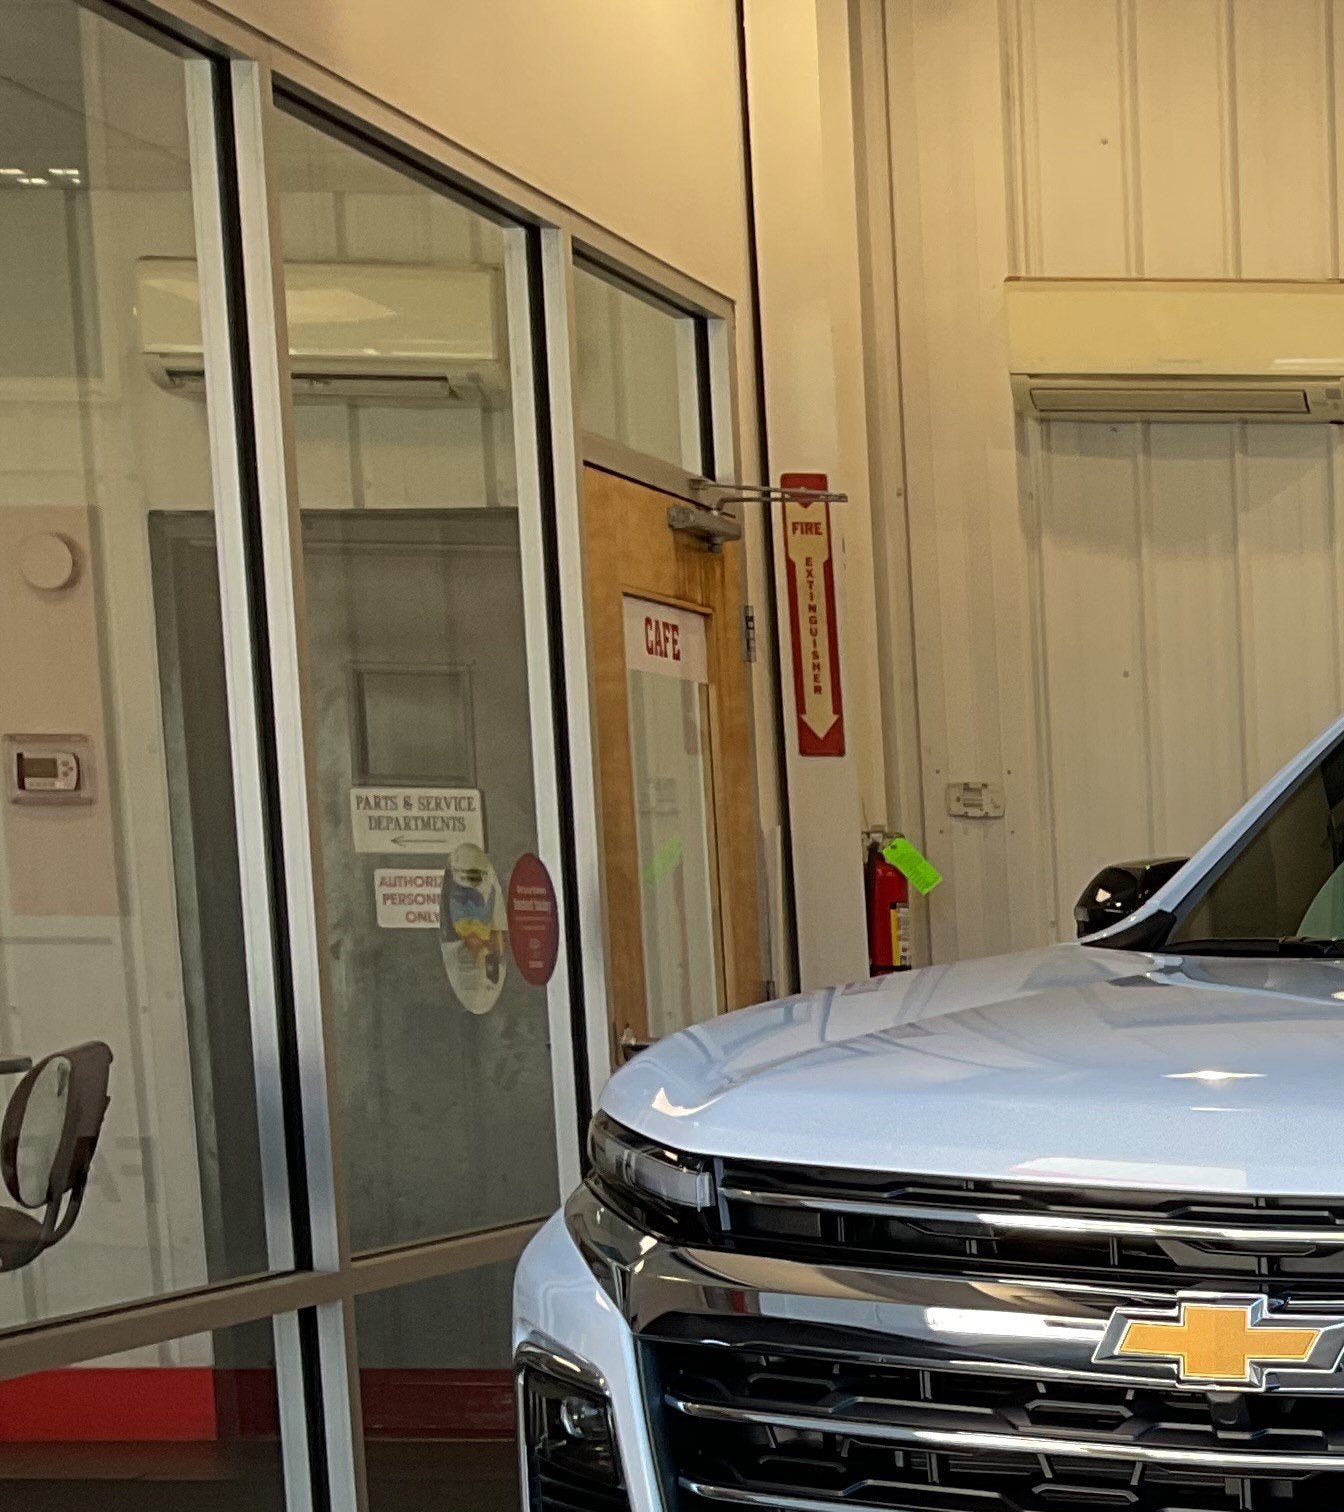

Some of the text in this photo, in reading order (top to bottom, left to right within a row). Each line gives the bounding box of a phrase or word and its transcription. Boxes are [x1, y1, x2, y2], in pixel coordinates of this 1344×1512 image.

[791, 521, 823, 536] FIRE
[804, 556, 823, 695] EXTINGUISHER
[644, 616, 681, 661] CAFE
[355, 795, 477, 812] PARTS & SERVICE
[368, 815, 466, 832] DEPARTMENTS
